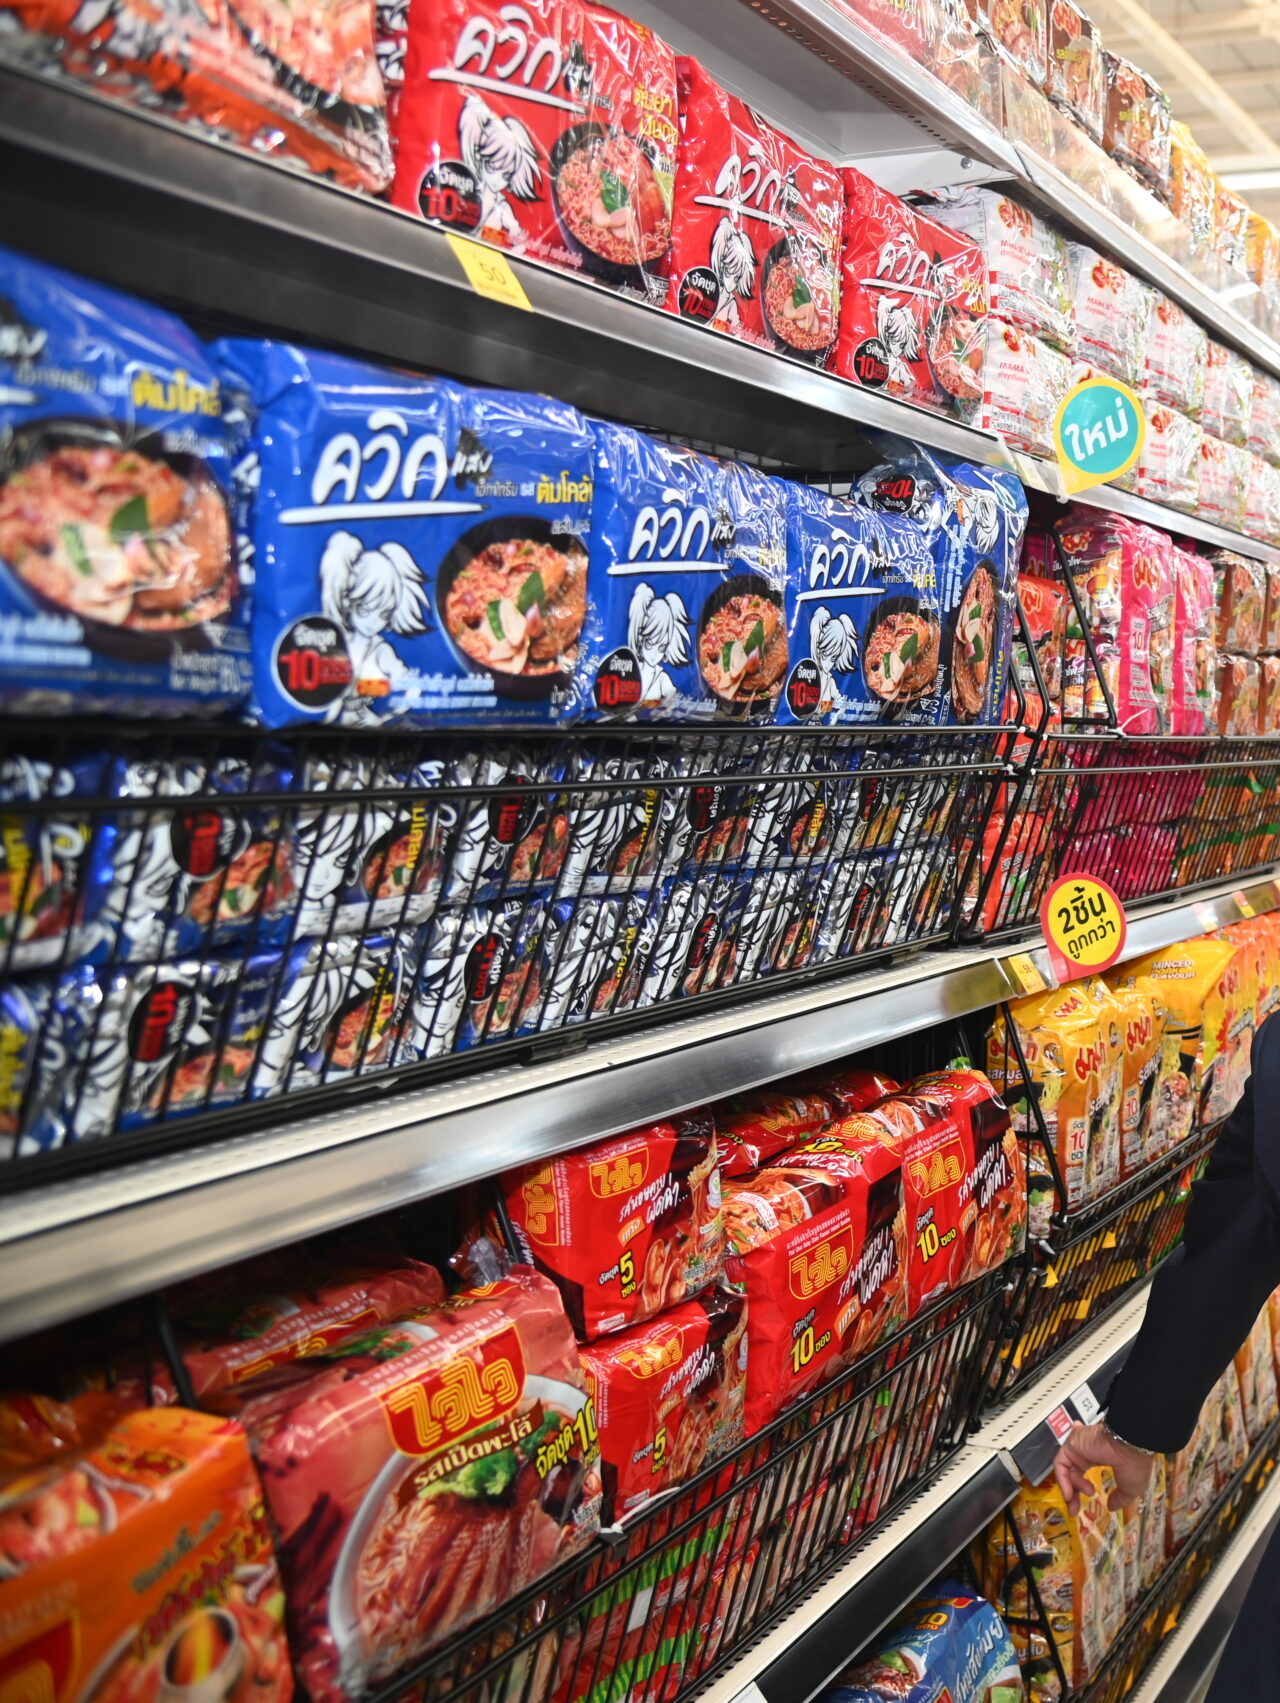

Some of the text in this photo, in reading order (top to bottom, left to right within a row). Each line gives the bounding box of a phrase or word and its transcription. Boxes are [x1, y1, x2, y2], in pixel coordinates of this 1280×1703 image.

[454, 4, 563, 92] ควิก
[422, 186, 457, 222] 10
[480, 261, 507, 286] 50
[691, 272, 717, 294] จัดชุด
[857, 355, 875, 381] 10
[1064, 396, 1129, 462] ใหม่
[312, 410, 449, 504] ควิก
[537, 470, 593, 504] ต้มโคล้
[628, 489, 710, 561] ควิก
[810, 528, 870, 589] ควิก
[1132, 631, 1143, 650] 10
[279, 649, 320, 691] 10
[797, 664, 817, 684] จัดชุด
[597, 674, 620, 707] 10
[789, 682, 806, 707] 10
[1056, 885, 1106, 934] 2ชิ้น
[1067, 917, 1117, 959] ถูกกว่า
[1151, 972, 1196, 980] FLAVOUR
[1152, 959, 1195, 970] MINCED
[592, 1157, 643, 1195] ไวไว
[916, 1206, 934, 1232] จัดชุด
[916, 1222, 957, 1264] 10 ซอง
[597, 1263, 620, 1286] จัดชุด
[619, 1250, 635, 1284] 5
[792, 1243, 847, 1296] ไวไว
[620, 1281, 637, 1299] ซอง
[792, 1307, 816, 1338] จัดชุด
[790, 1326, 831, 1374] 10 ซอง
[388, 1356, 519, 1448] ไวไว
[413, 1413, 533, 1490] รสเป็ดพะโล้
[536, 1396, 599, 1479] จัดชุด 10
[653, 1427, 667, 1462] 5
[651, 1456, 667, 1475] ซอง
